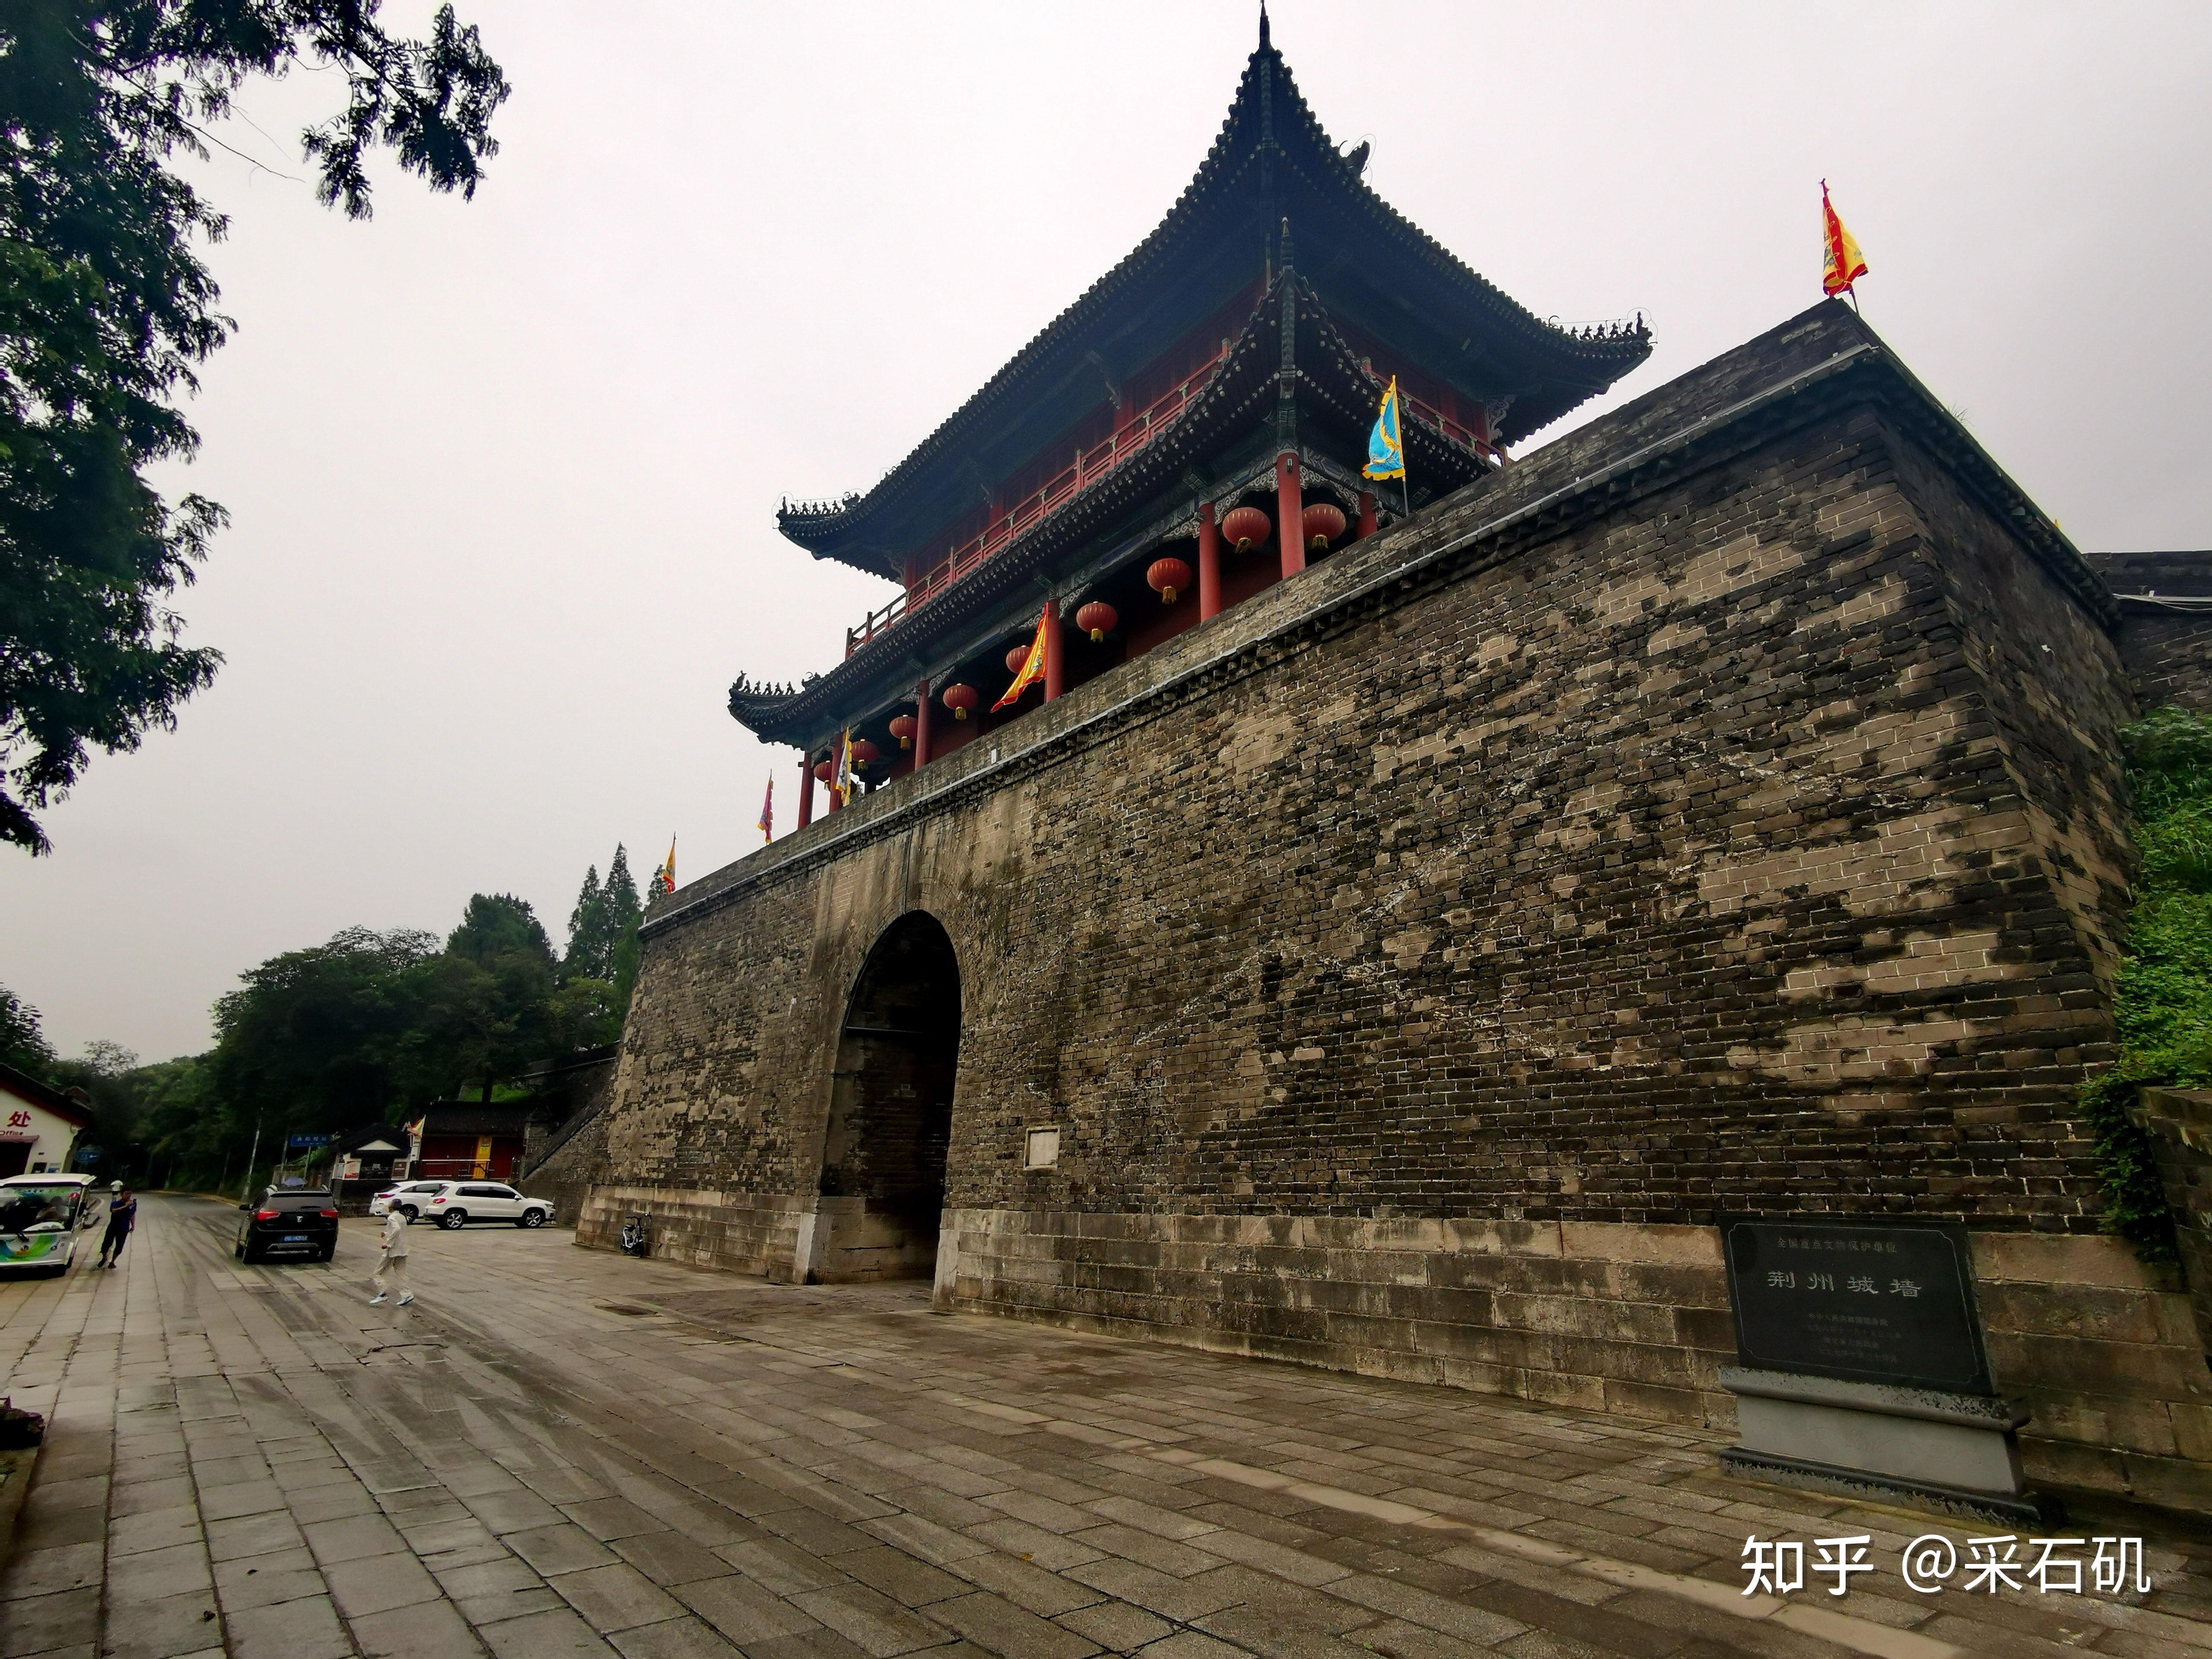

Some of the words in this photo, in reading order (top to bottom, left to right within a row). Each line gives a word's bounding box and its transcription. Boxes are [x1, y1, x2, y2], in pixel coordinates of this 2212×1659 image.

[7, 1111, 32, 1127] 处
[1767, 1270, 1922, 1298] 荆州城墙
